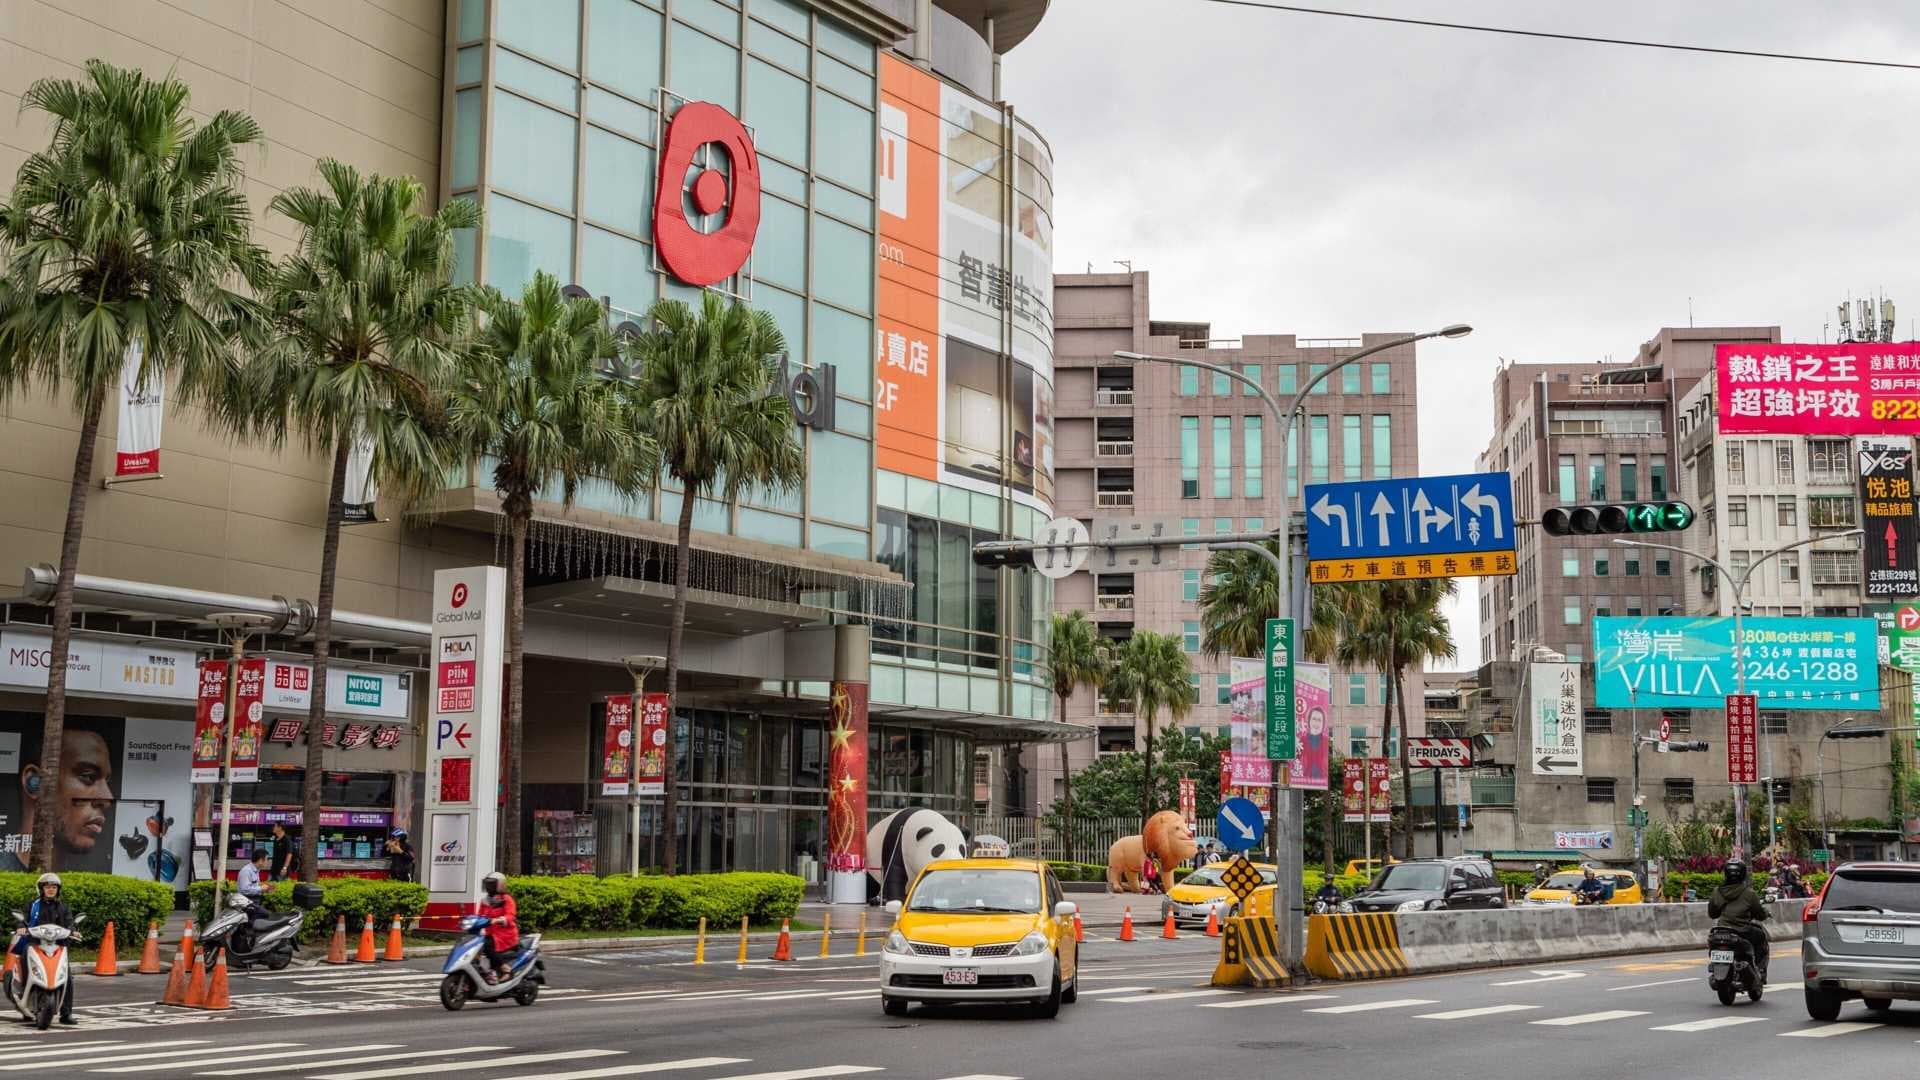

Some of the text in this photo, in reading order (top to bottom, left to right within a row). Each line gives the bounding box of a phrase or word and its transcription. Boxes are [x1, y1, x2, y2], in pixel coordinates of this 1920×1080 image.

[1729, 355, 1860, 383] 熱銷之王
[1730, 388, 1861, 418] 超強坪效
[1865, 502, 1913, 517] 精品旅館
[1314, 555, 1511, 580] 前方車道預告標誌
[1869, 583, 1919, 595] 2221-1234
[436, 609, 482, 624] Global Mall
[1273, 624, 1288, 640] 東
[1617, 629, 1684, 663] 灣岸
[1731, 661, 1858, 681] 2246-1288
[349, 679, 380, 691] NITORI
[1560, 667, 1577, 747] 小巢迷你倉
[438, 720, 453, 750] P
[128, 741, 191, 751] SoundSport Free
[1416, 747, 1461, 758] FRIDAYS
[944, 971, 977, 982] 453-E3
